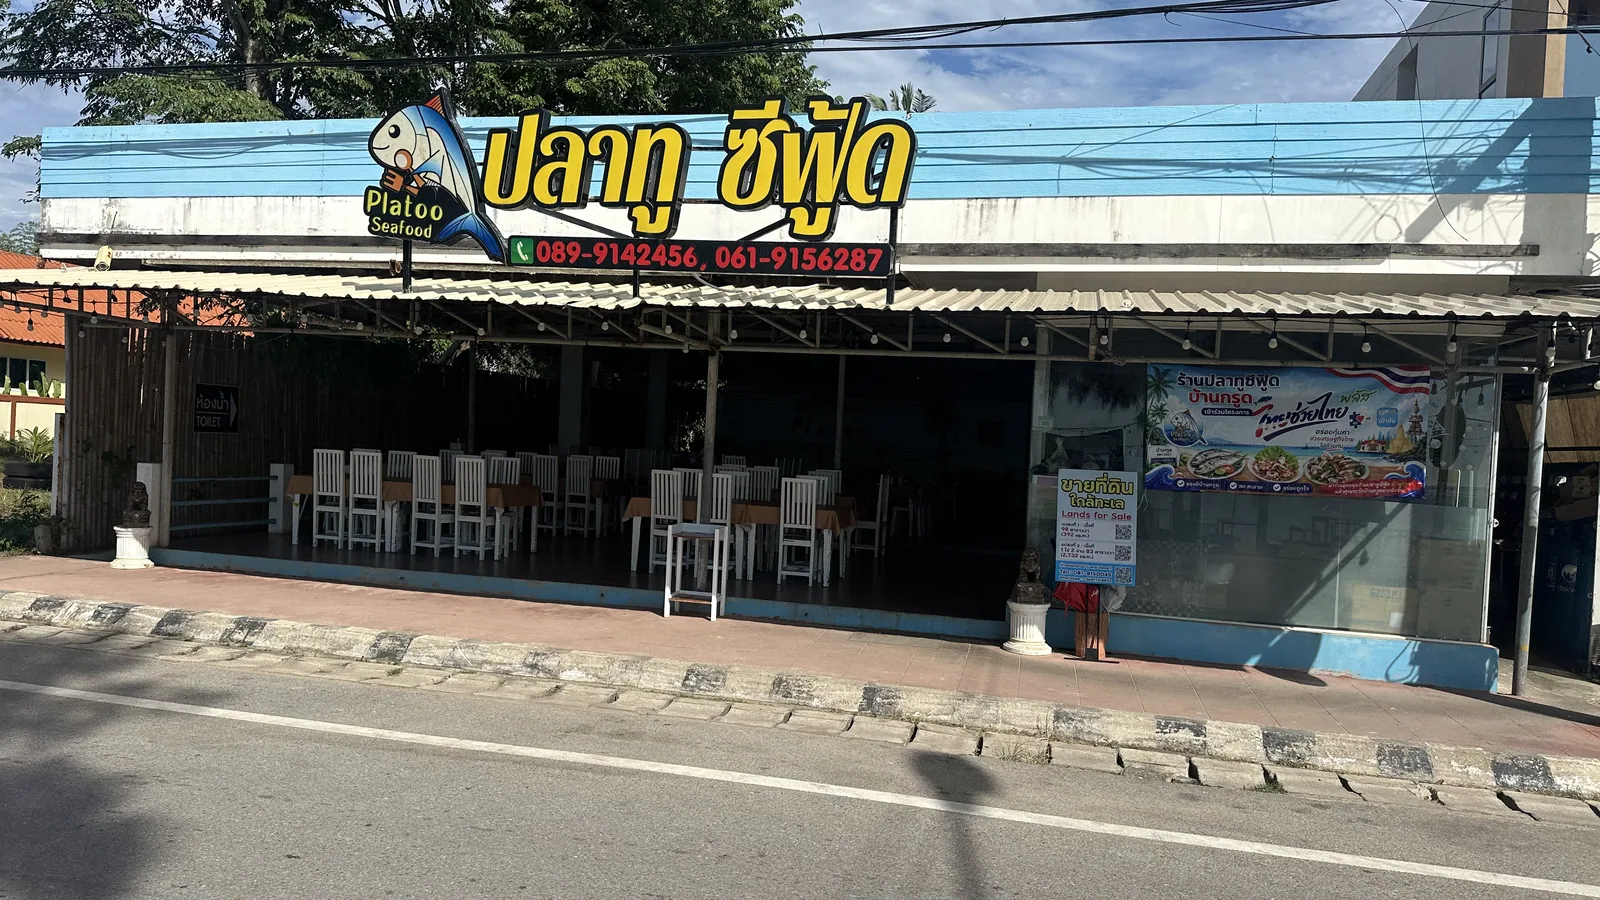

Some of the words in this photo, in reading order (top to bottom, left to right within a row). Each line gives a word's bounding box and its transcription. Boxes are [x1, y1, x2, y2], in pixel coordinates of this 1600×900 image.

[482, 112, 685, 235] ปลาทู
[719, 99, 912, 236] ซีฟู้ด
[366, 189, 443, 221] Platoo
[371, 217, 432, 238] Seafood
[715, 246, 884, 272] 061-9156287
[1177, 372, 1280, 391] ร้านปลาทูซีฟู้ด
[196, 390, 229, 411] ห้องน้ำ
[1188, 388, 1253, 407] บ้านกรูด
[1340, 389, 1379, 404] พลัส
[196, 415, 221, 428] TOILET
[1203, 408, 1251, 416] เข้าร่วมโครงการ
[1315, 428, 1350, 437] อร่อยคุ้มค่า
[1061, 472, 1134, 496] ขายที่ดิน
[1069, 493, 1126, 509] ใกล้ทะเล
[1061, 510, 1091, 519] Lands
[1094, 511, 1108, 519] for
[1111, 512, 1132, 521] Sale
